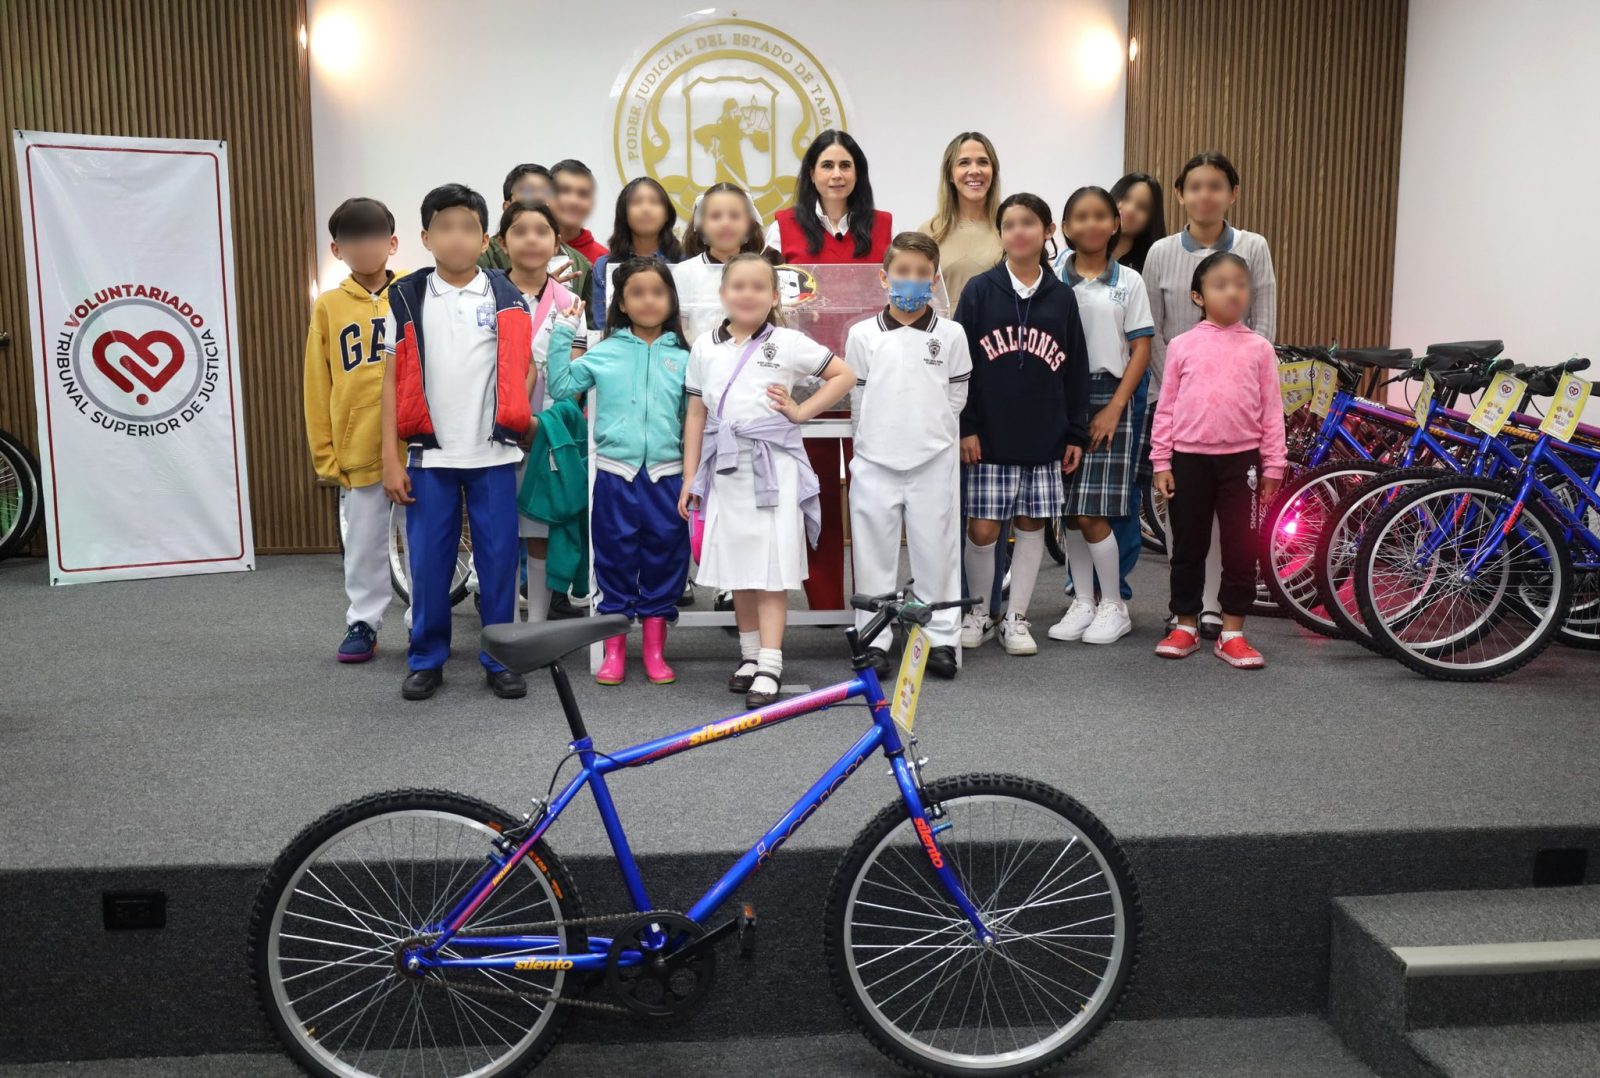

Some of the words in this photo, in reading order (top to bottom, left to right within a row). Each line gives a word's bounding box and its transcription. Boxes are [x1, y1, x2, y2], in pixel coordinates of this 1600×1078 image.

[627, 106, 642, 161] PODER
[635, 42, 693, 104] JUDICIAL
[696, 33, 727, 50] DEL
[732, 33, 793, 64] ESTADO
[793, 62, 815, 84] DE
[811, 84, 833, 127] TABA
[64, 284, 204, 328] VOLUNTARIADO
[339, 317, 386, 372] GA
[980, 326, 1066, 372] HALCONES
[56, 331, 90, 414] TRIBUNAL
[90, 410, 181, 437] SUPERIOR
[181, 400, 204, 423] DE
[198, 328, 219, 402] JUSTICIA
[688, 715, 762, 747] silento
[913, 817, 944, 869] silento
[514, 957, 574, 972] silento
